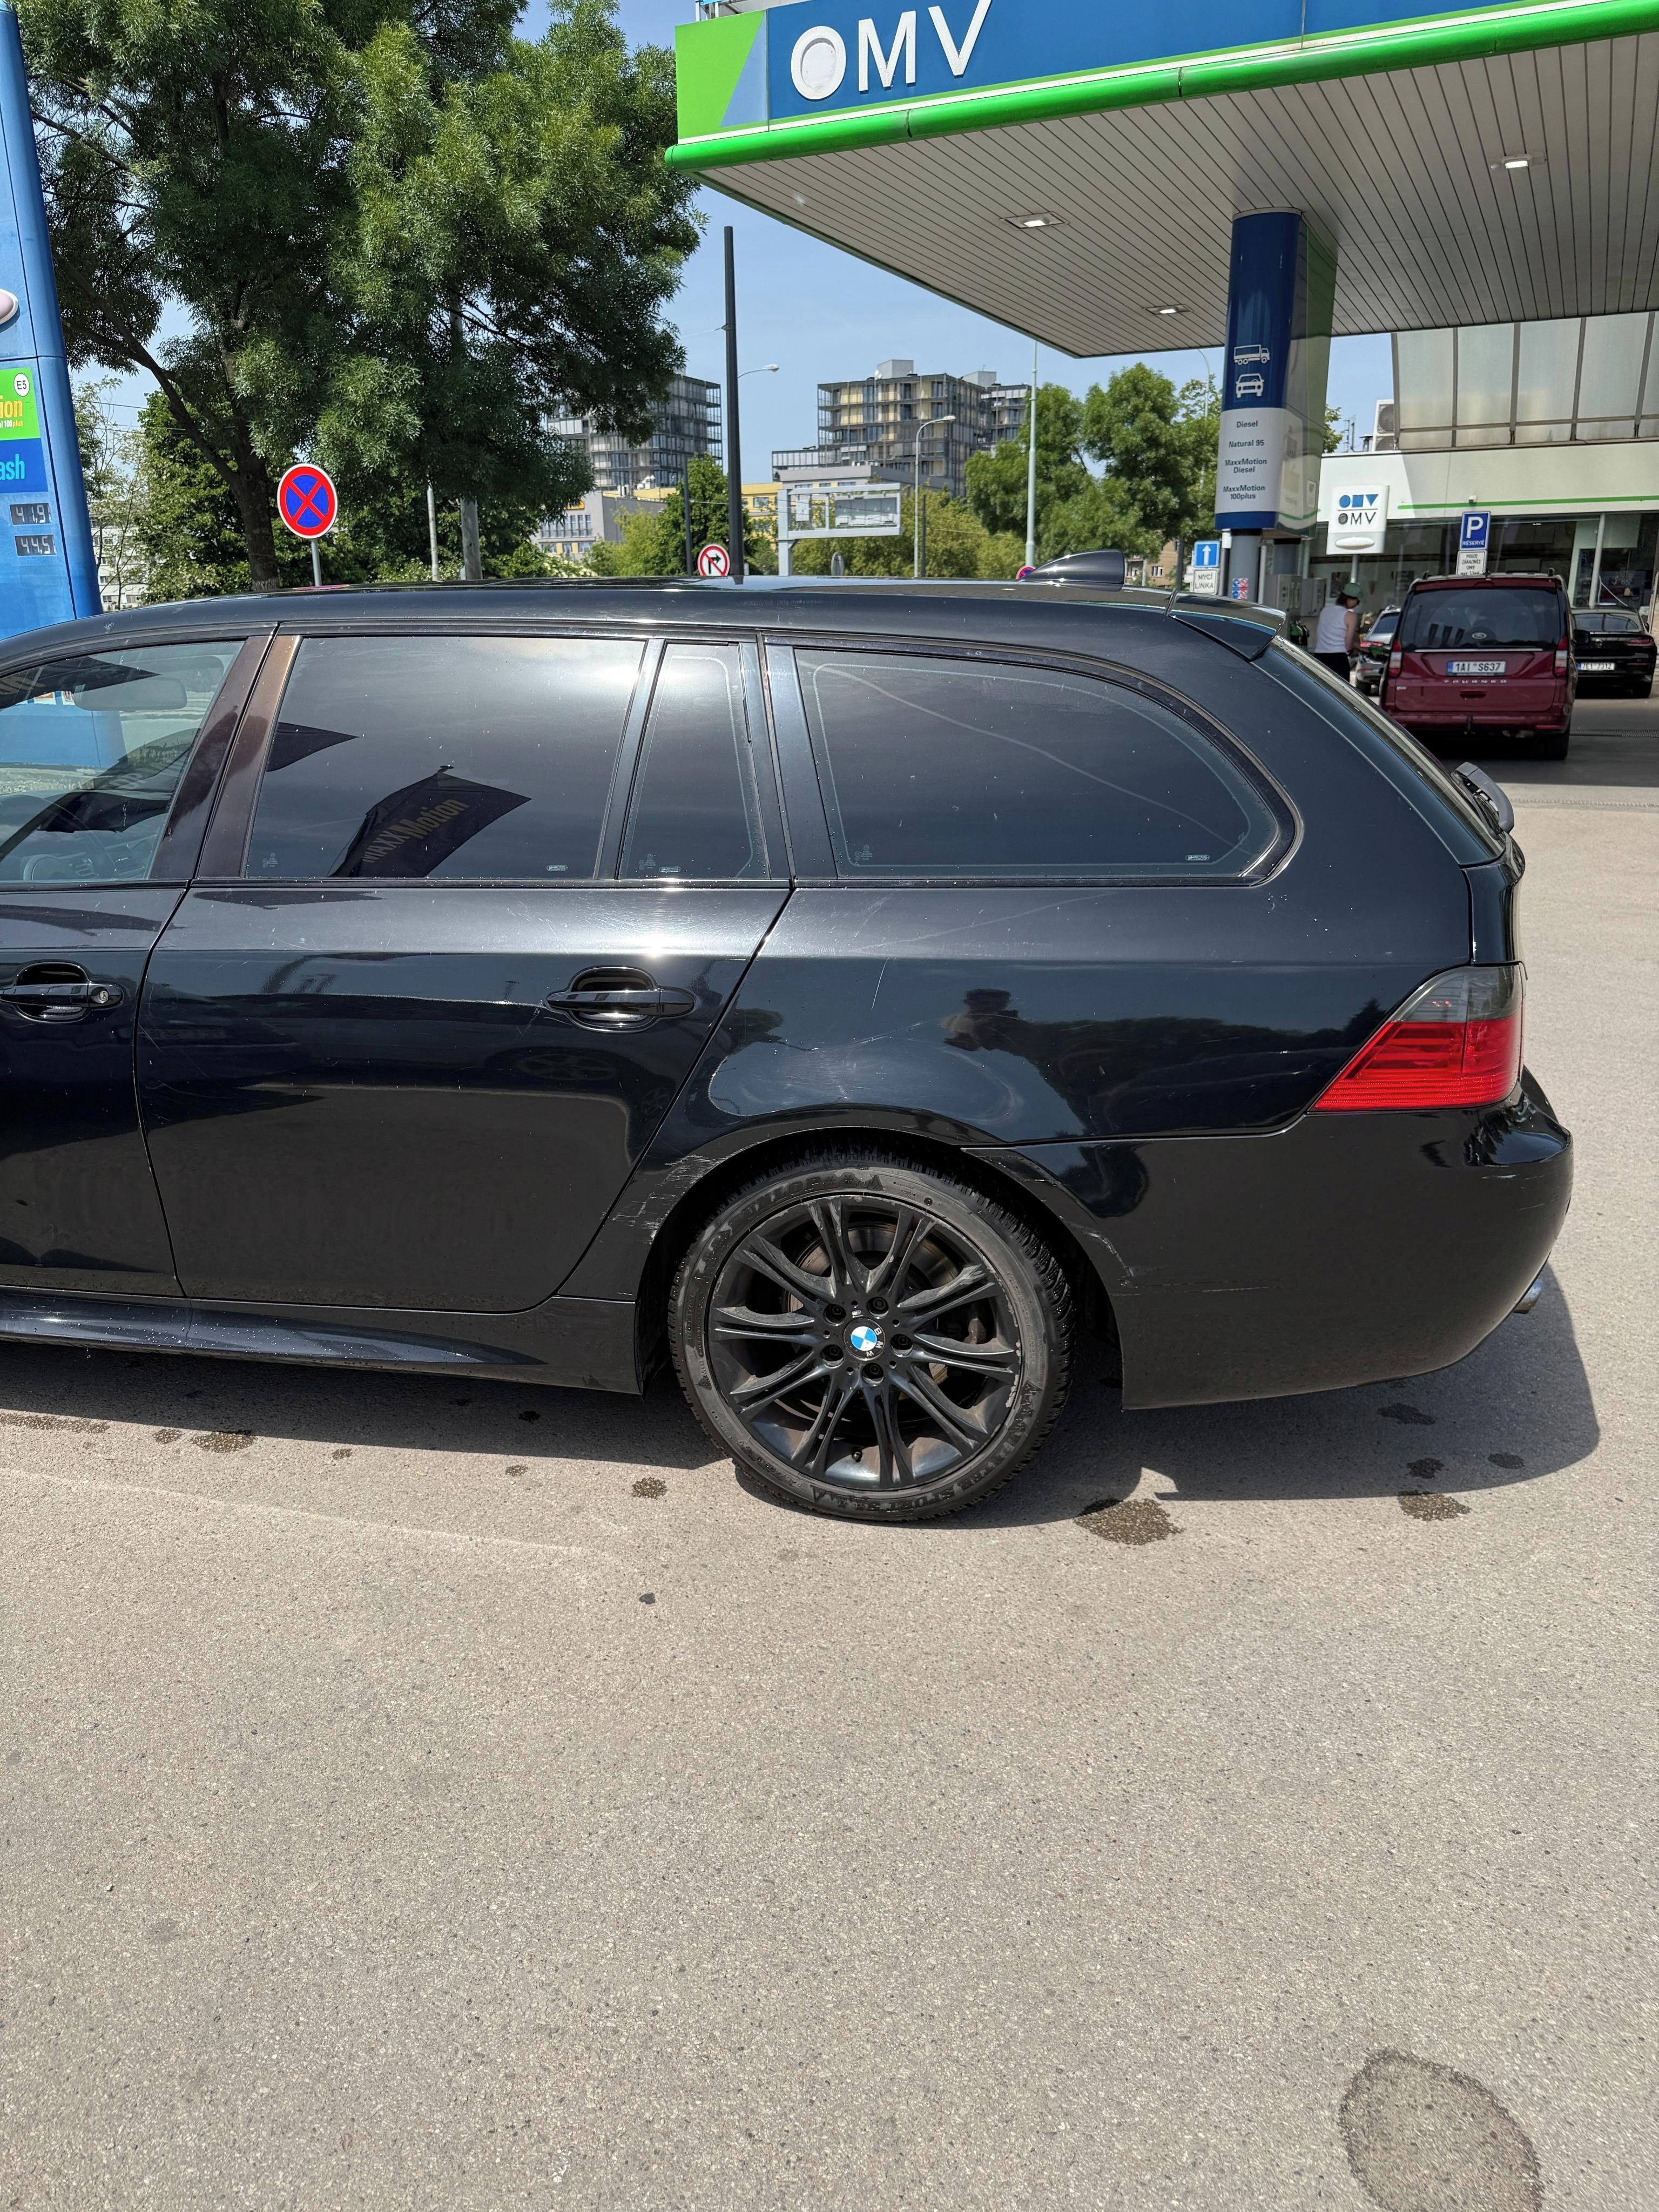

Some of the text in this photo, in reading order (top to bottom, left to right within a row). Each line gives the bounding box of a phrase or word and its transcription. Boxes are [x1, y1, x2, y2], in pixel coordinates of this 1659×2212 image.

[791, 0, 992, 100] OMV
[17, 380, 27, 390] E5
[1229, 440, 1254, 448] Natural
[1230, 493, 1257, 501] 100plus
[1338, 511, 1376, 525] OMV
[1466, 516, 1483, 538] P
[865, 1327, 884, 1357] BMW
